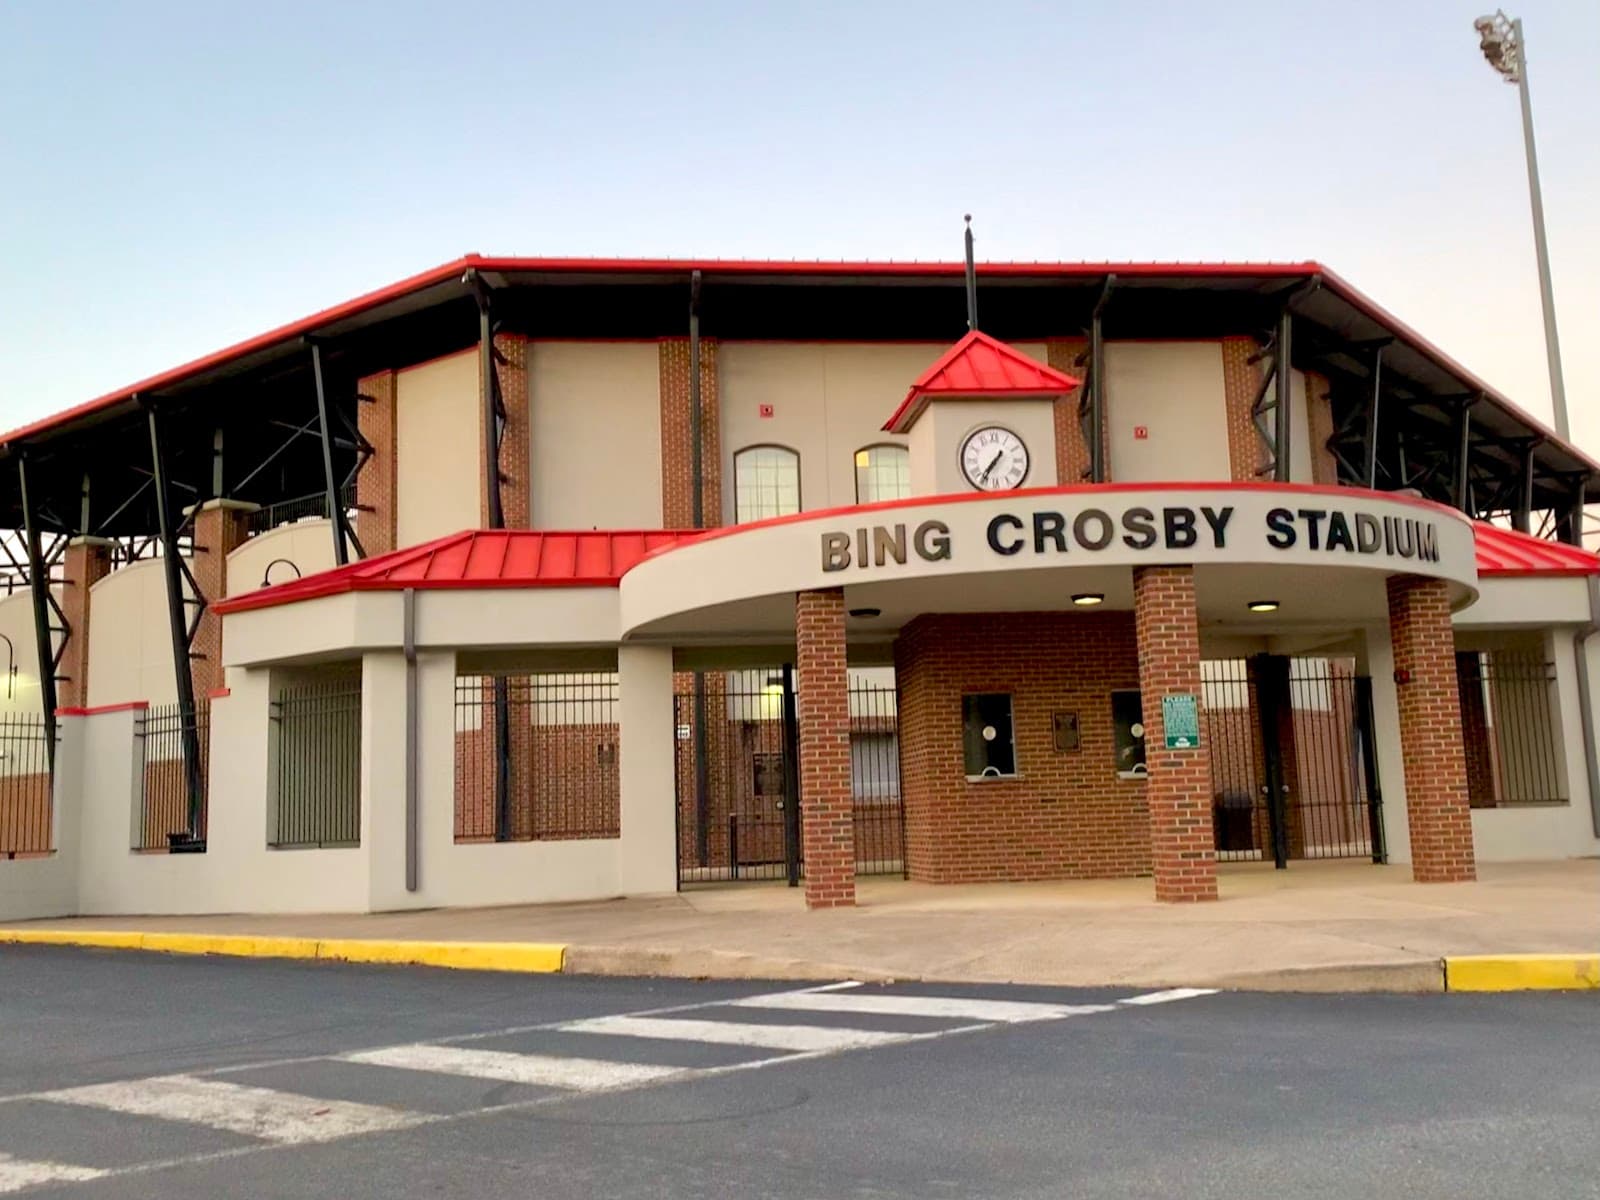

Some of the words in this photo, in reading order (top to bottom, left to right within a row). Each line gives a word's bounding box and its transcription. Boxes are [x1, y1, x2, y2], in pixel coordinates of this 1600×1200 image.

[821, 520, 952, 572] BING
[986, 506, 1234, 556] CROSBY
[1266, 508, 1440, 562] STADIUM
